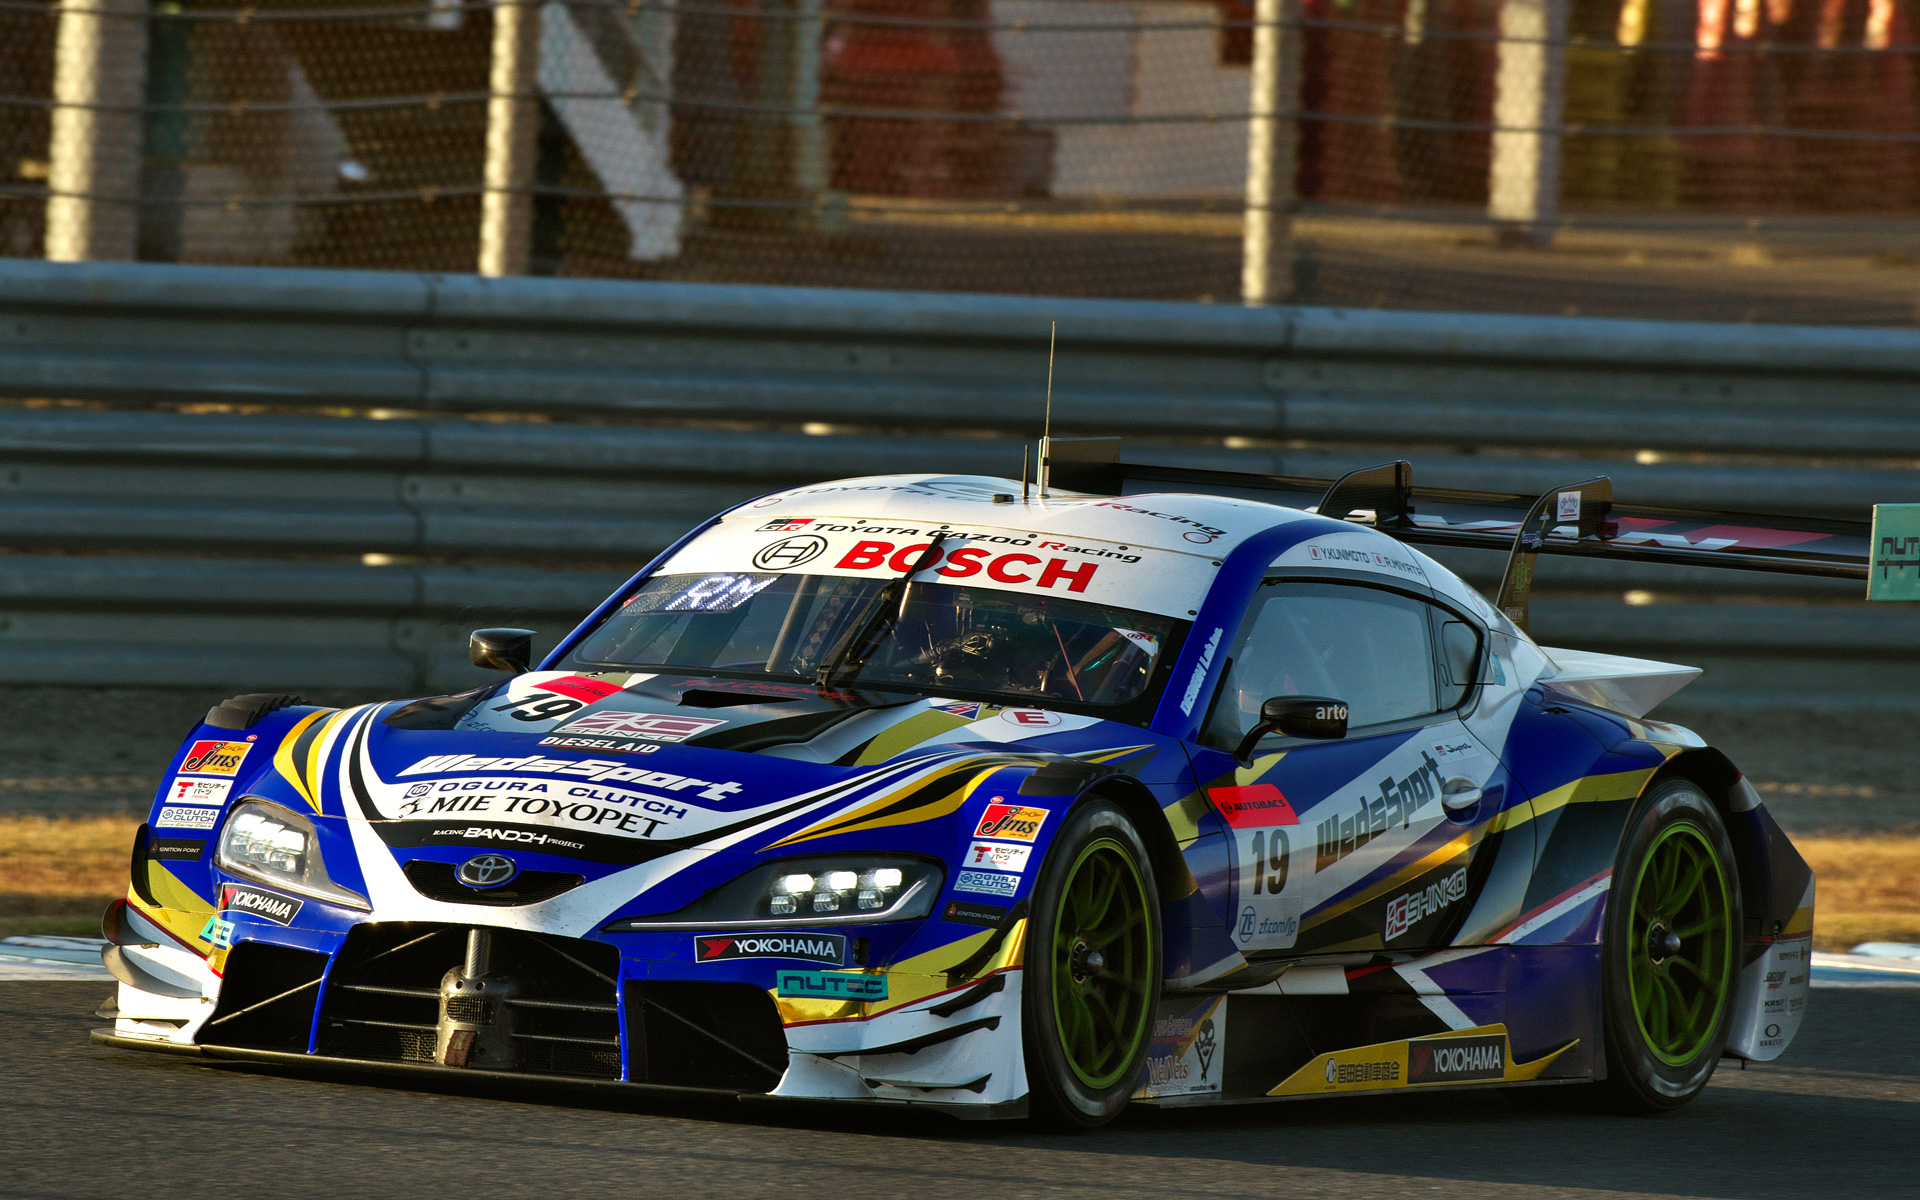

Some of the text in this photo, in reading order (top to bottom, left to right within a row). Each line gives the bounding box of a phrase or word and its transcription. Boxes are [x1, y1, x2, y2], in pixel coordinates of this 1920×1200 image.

[1094, 502, 1228, 536] Racing
[813, 523, 1142, 564] TOYOTA GAZOO Racing
[1880, 536, 1920, 556] NUT
[834, 540, 1099, 593] BOSCH
[492, 693, 583, 722] 19
[1315, 704, 1348, 721] arto
[395, 753, 745, 802] WedsSport
[175, 808, 216, 817] OGURA
[438, 780, 689, 820] OGURA CLUTCH
[1234, 799, 1286, 812] AUTOBACS
[1315, 750, 1447, 875] WedsSport
[173, 813, 215, 823] CLUTCH
[427, 795, 671, 838] MIE TOYOPET
[432, 828, 464, 837] RACING
[547, 837, 586, 850] PROJECT
[1251, 828, 1290, 896] 19
[972, 879, 1015, 890] CLUTCH
[974, 873, 1017, 884] OGURA
[231, 890, 293, 919] YOKOHAMA
[1407, 867, 1467, 923] SHINKO
[957, 910, 981, 918] IGNITION
[1258, 916, 1297, 937] zf.com/jp
[734, 937, 837, 959] YOKOHAMA
[1433, 1045, 1502, 1073] YOKOHAMA
